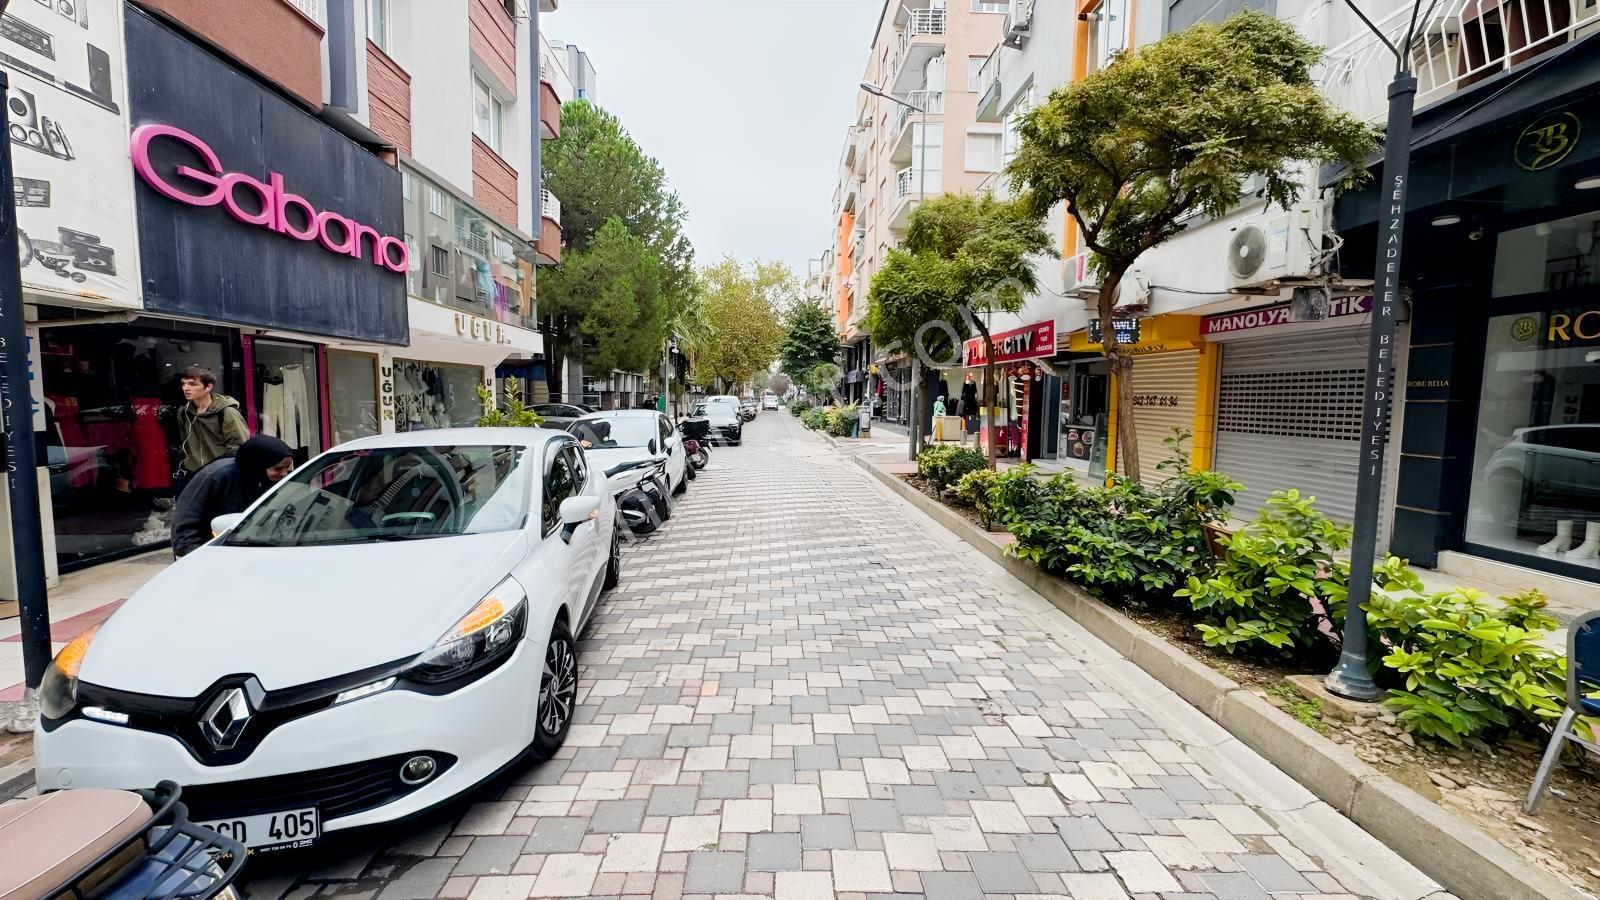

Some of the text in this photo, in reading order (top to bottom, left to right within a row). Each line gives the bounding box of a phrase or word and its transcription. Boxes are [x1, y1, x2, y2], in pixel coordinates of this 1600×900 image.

[130, 123, 408, 273] Gabana
[1382, 175, 1403, 316] ŞEHZADELER
[1208, 307, 1291, 333] MANOLYA
[381, 366, 394, 421] UĞUR
[202, 810, 314, 844] CD 405
